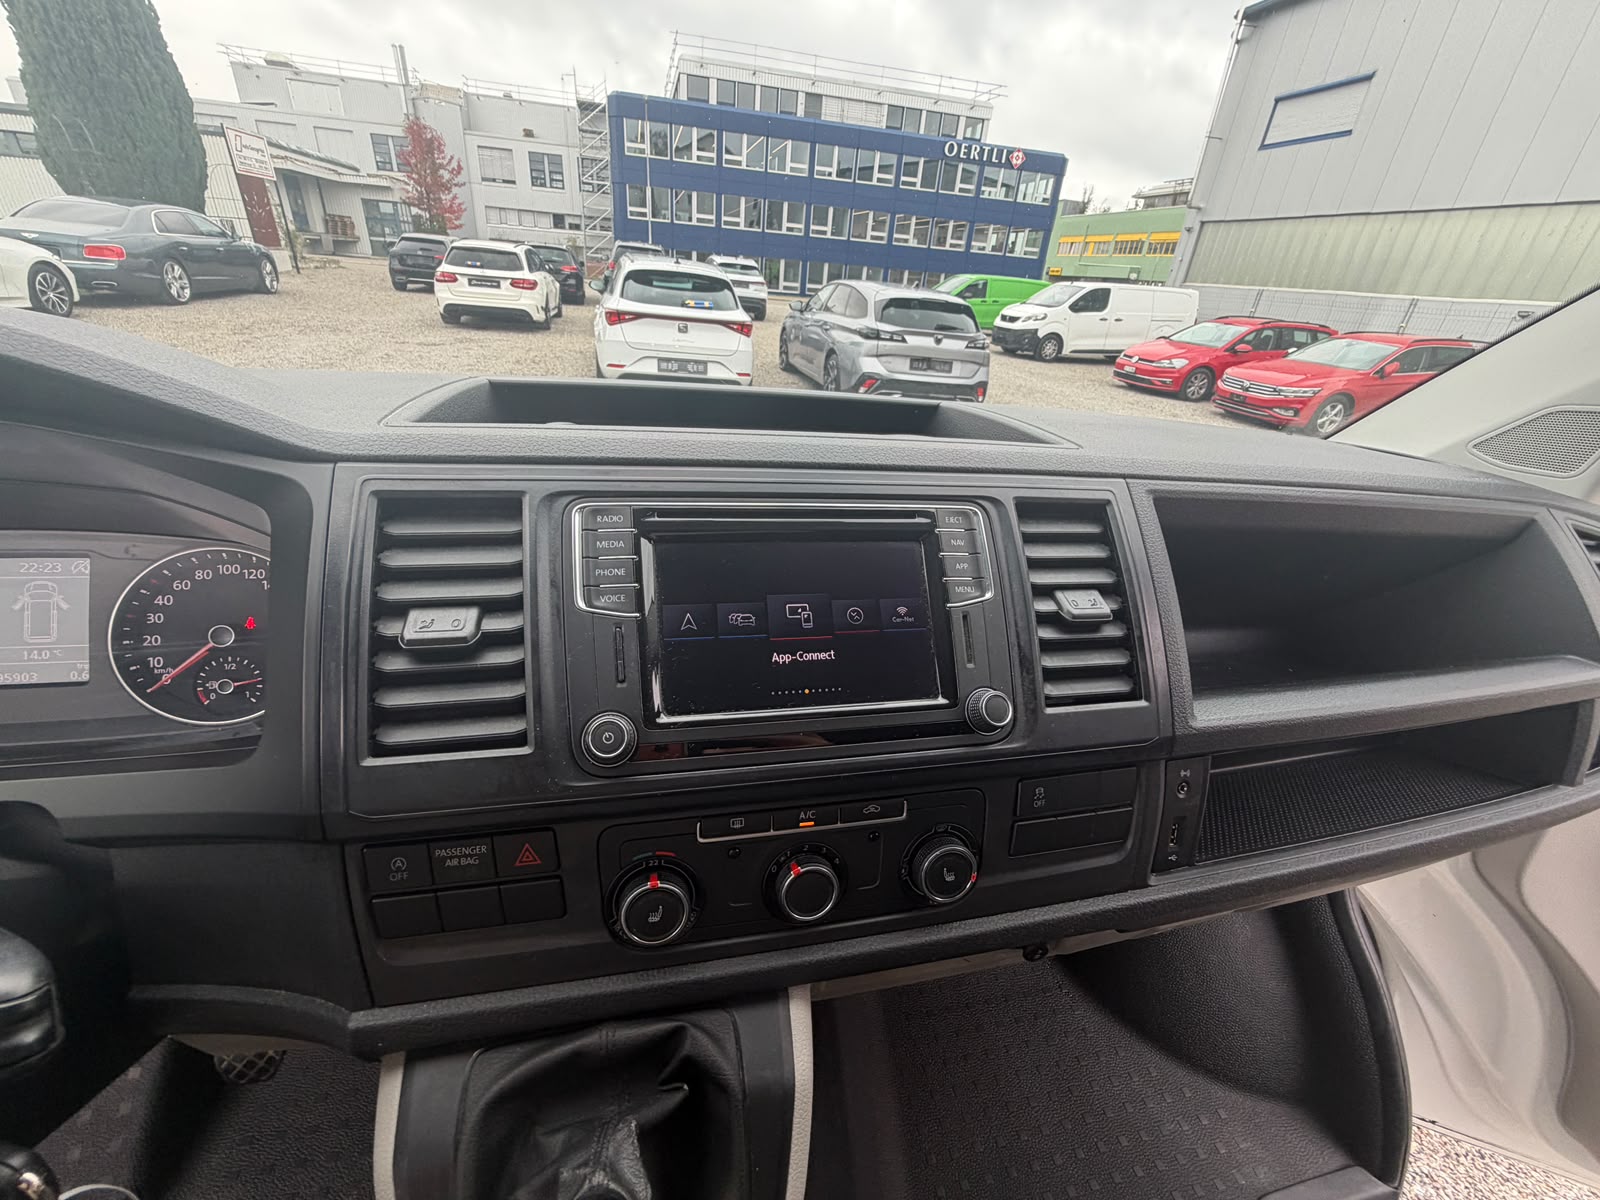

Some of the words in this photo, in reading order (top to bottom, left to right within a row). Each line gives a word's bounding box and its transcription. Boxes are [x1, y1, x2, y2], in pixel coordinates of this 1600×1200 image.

[944, 140, 1008, 164] OERTLI
[596, 514, 624, 523] RADIO
[945, 516, 962, 524] EJECT
[596, 540, 625, 549] MEDIA
[19, 562, 62, 574] 22:23
[217, 563, 241, 575] 100
[955, 562, 969, 570] APP
[195, 569, 212, 580] 80
[242, 568, 266, 580] 120
[595, 567, 626, 577] PHONE
[173, 579, 191, 590] 60
[154, 595, 174, 606] 40
[599, 593, 626, 603] VOICE
[146, 613, 164, 624] 30
[142, 635, 161, 646] 20
[23, 649, 50, 661] 14.0
[771, 649, 836, 665] App-Connect
[147, 656, 164, 668] 10
[224, 663, 237, 671] 1/2
[70, 670, 90, 681] 0.6
[154, 667, 175, 675] km/h
[1033, 799, 1046, 808] OFF
[799, 810, 816, 820] A/C
[435, 845, 488, 857] PASSENGER
[444, 857, 460, 867] AIR
[460, 856, 479, 866] BAG
[389, 871, 409, 881] OFF
